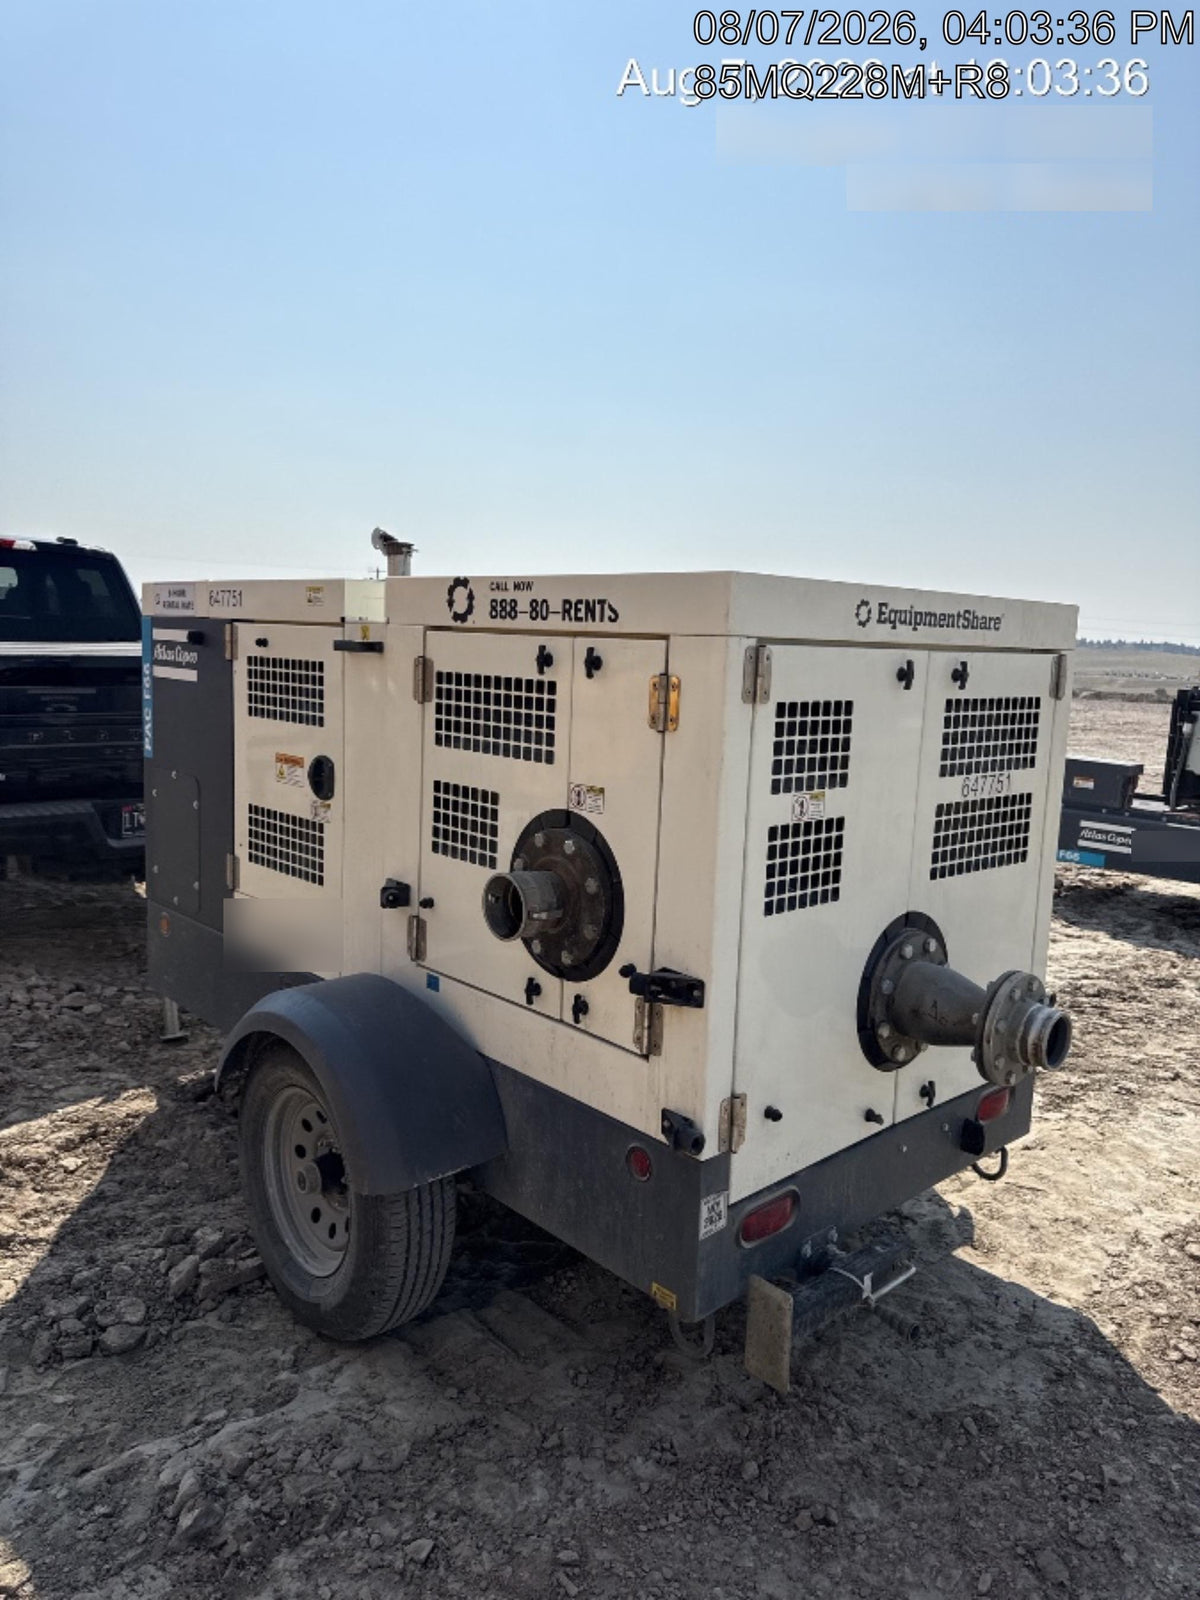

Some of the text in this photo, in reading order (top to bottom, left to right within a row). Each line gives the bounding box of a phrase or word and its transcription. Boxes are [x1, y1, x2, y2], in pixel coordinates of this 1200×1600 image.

[208, 589, 243, 608] 647751
[489, 581, 534, 592] CALL NOW
[489, 598, 620, 623] 888-80-RENTS
[876, 602, 1002, 632] EquipmentShare
[961, 773, 1011, 798] 647751
